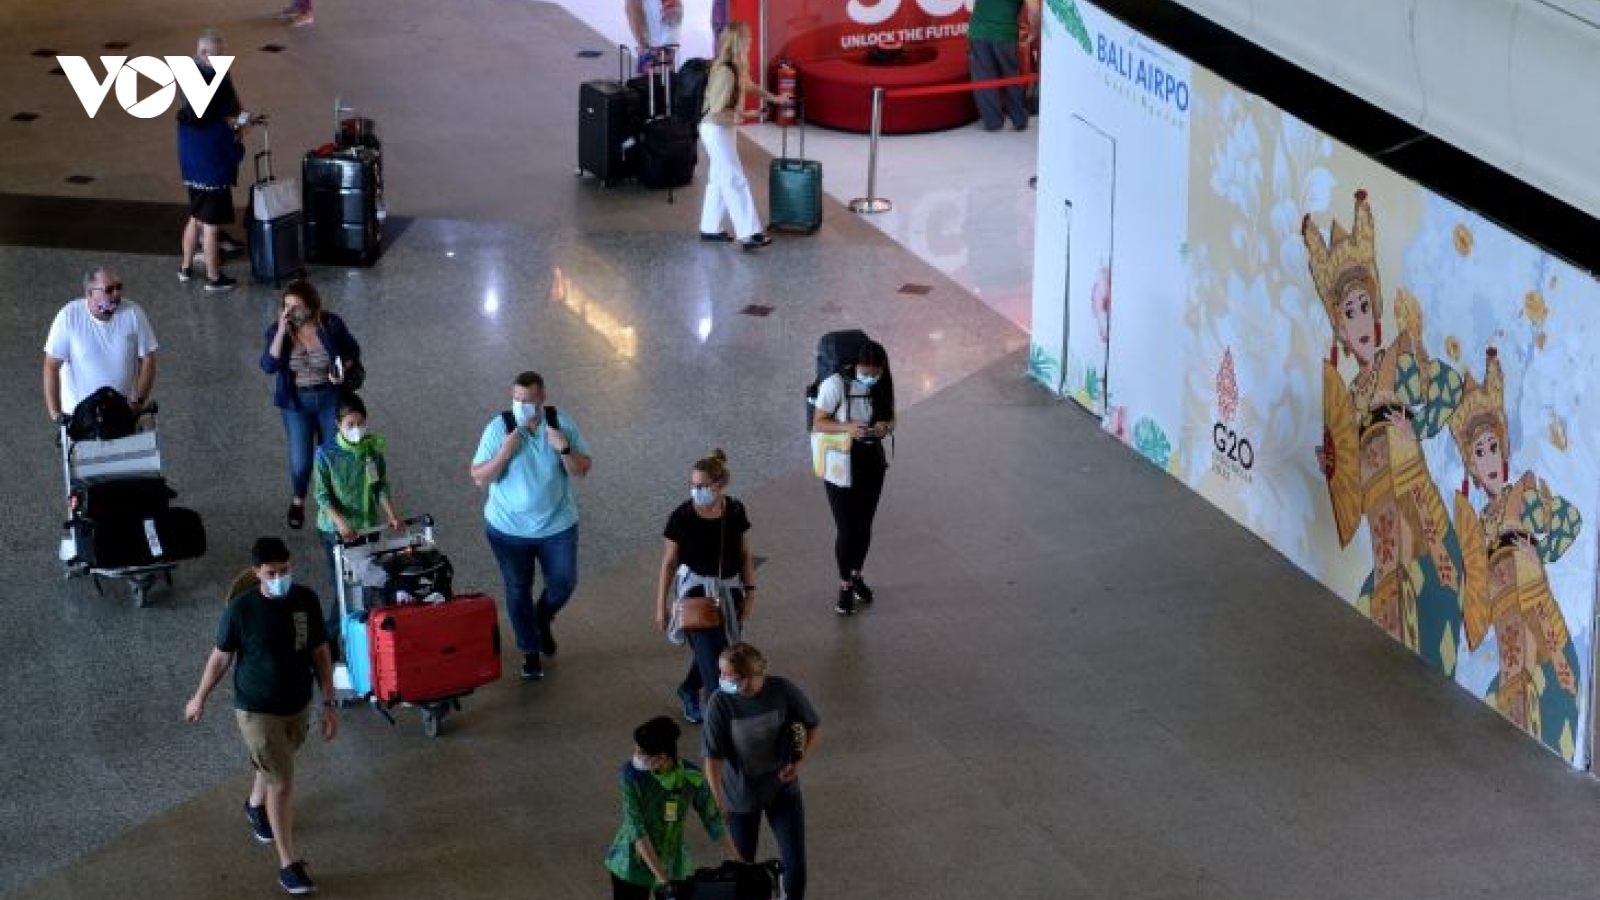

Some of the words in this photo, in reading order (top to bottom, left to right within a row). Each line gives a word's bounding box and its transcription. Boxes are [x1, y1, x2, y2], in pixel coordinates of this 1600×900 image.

[841, 30, 894, 49] UNLOCK
[896, 27, 924, 42] THE
[1097, 32, 1132, 80] BALI
[1135, 58, 1189, 111] AIRPO
[1213, 422, 1254, 470] G20
